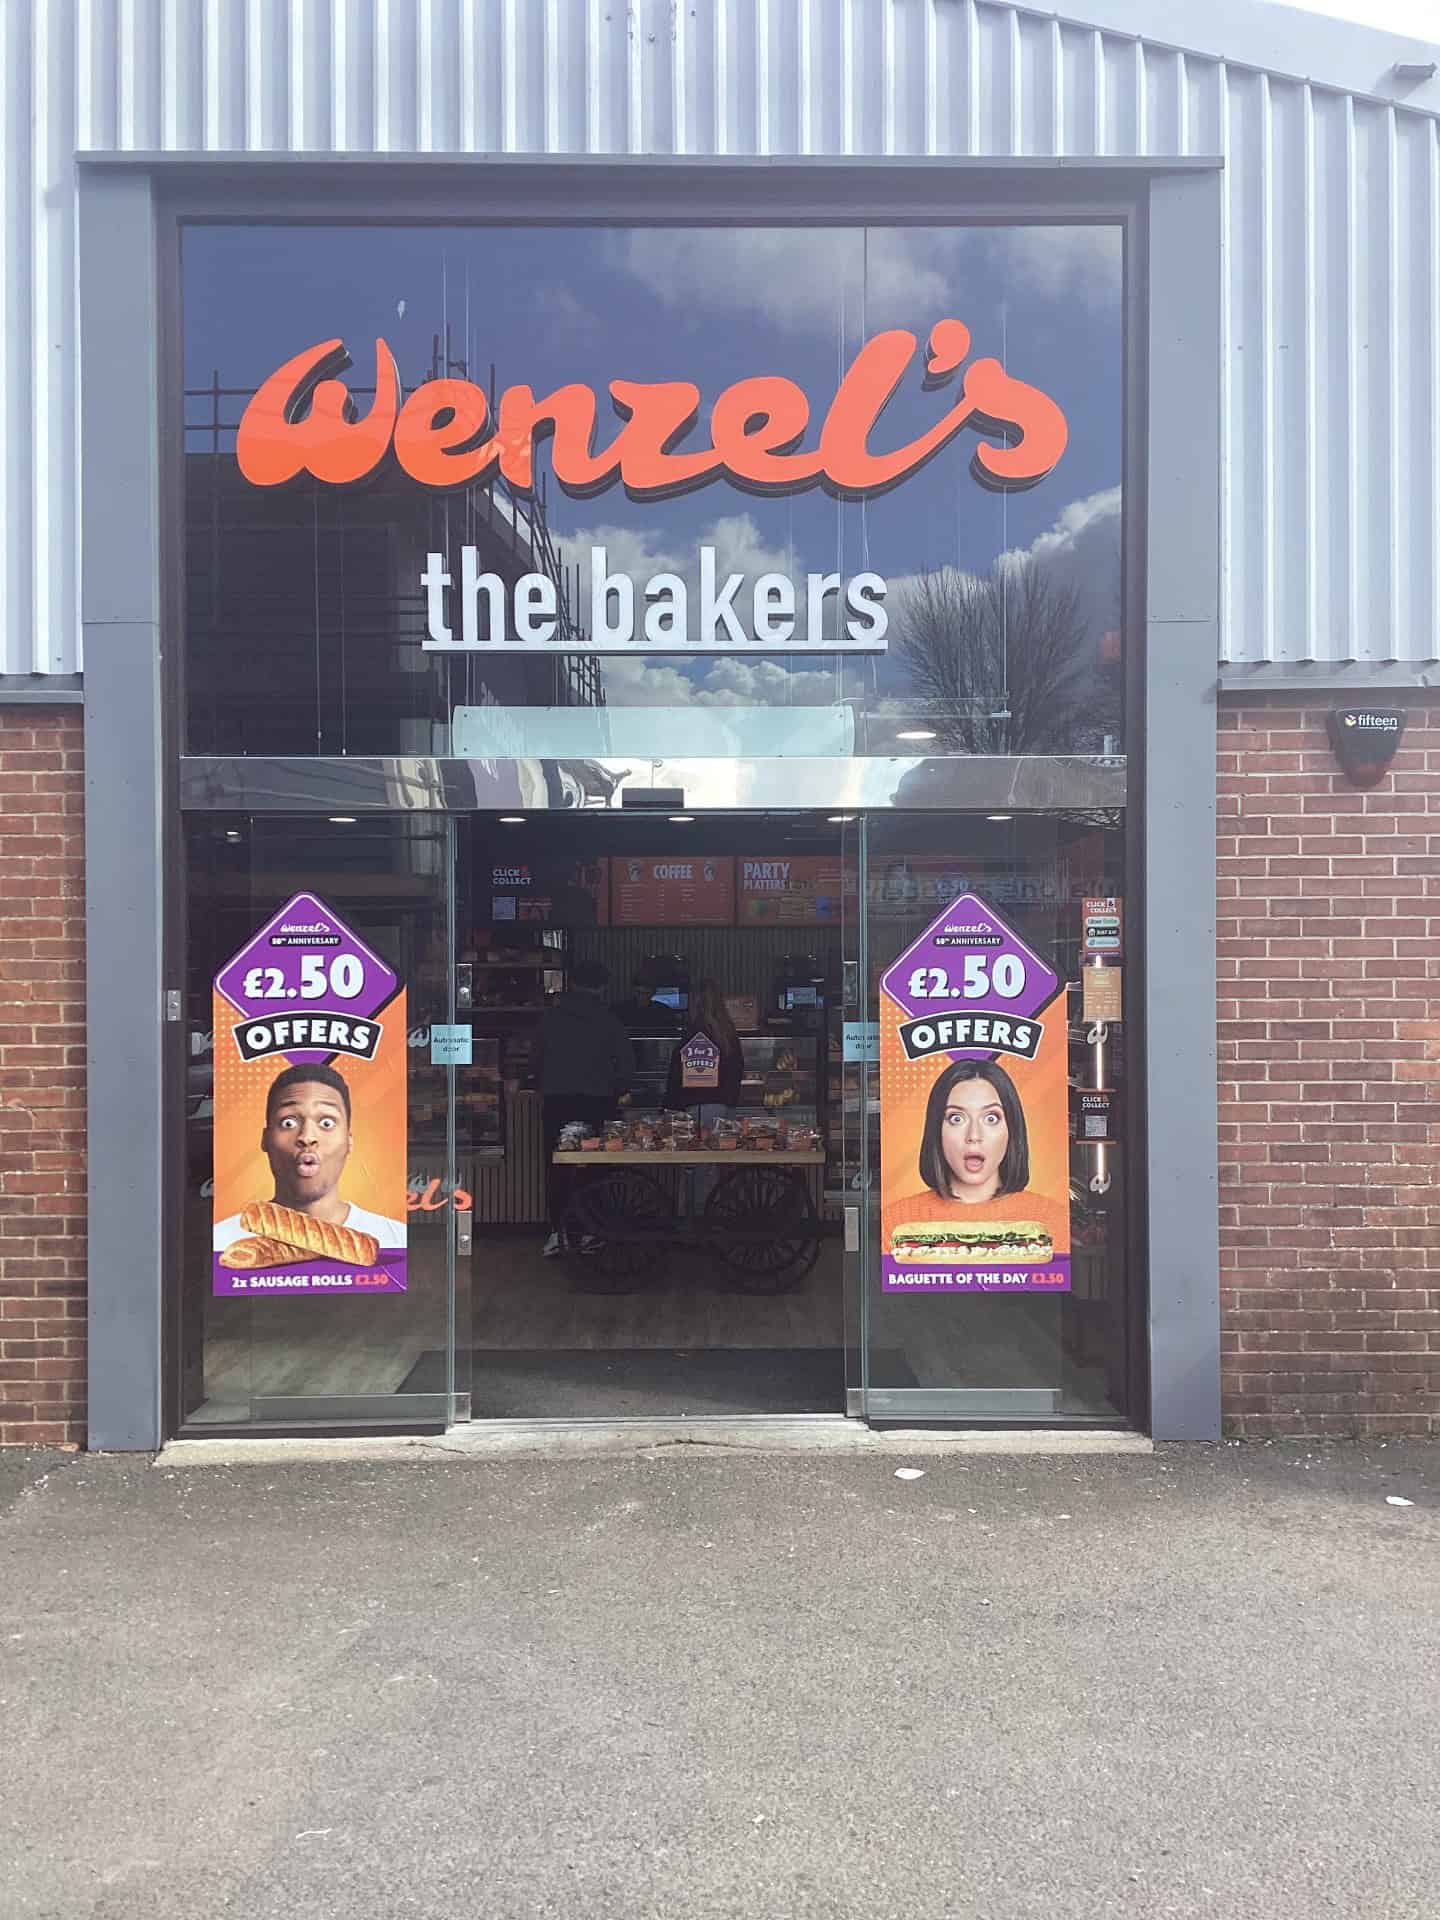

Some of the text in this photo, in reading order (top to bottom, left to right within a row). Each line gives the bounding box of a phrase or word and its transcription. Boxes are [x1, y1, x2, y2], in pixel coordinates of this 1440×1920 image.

[420, 546, 888, 642] the bakers
[1358, 714, 1398, 726] fifteen
[492, 868, 520, 876] CLICK
[653, 865, 694, 880] COFFEE
[744, 863, 791, 879] PARTY
[492, 877, 531, 885] COLLECT
[287, 937, 340, 945] ANNIVERSARY
[951, 937, 1001, 945] ANNIVERSARY
[243, 953, 364, 999] £2.50
[908, 953, 1026, 999] £2.50
[246, 1020, 371, 1050] OFFERS
[911, 1019, 1032, 1049] OFFERS
[231, 1273, 390, 1288] 2x SAUSAGE ROLLS £2.50
[888, 1273, 953, 1285] BAGUETTE
[955, 1273, 974, 1285] OF
[976, 1273, 1000, 1284] THE
[1002, 1273, 1029, 1284] DAY
